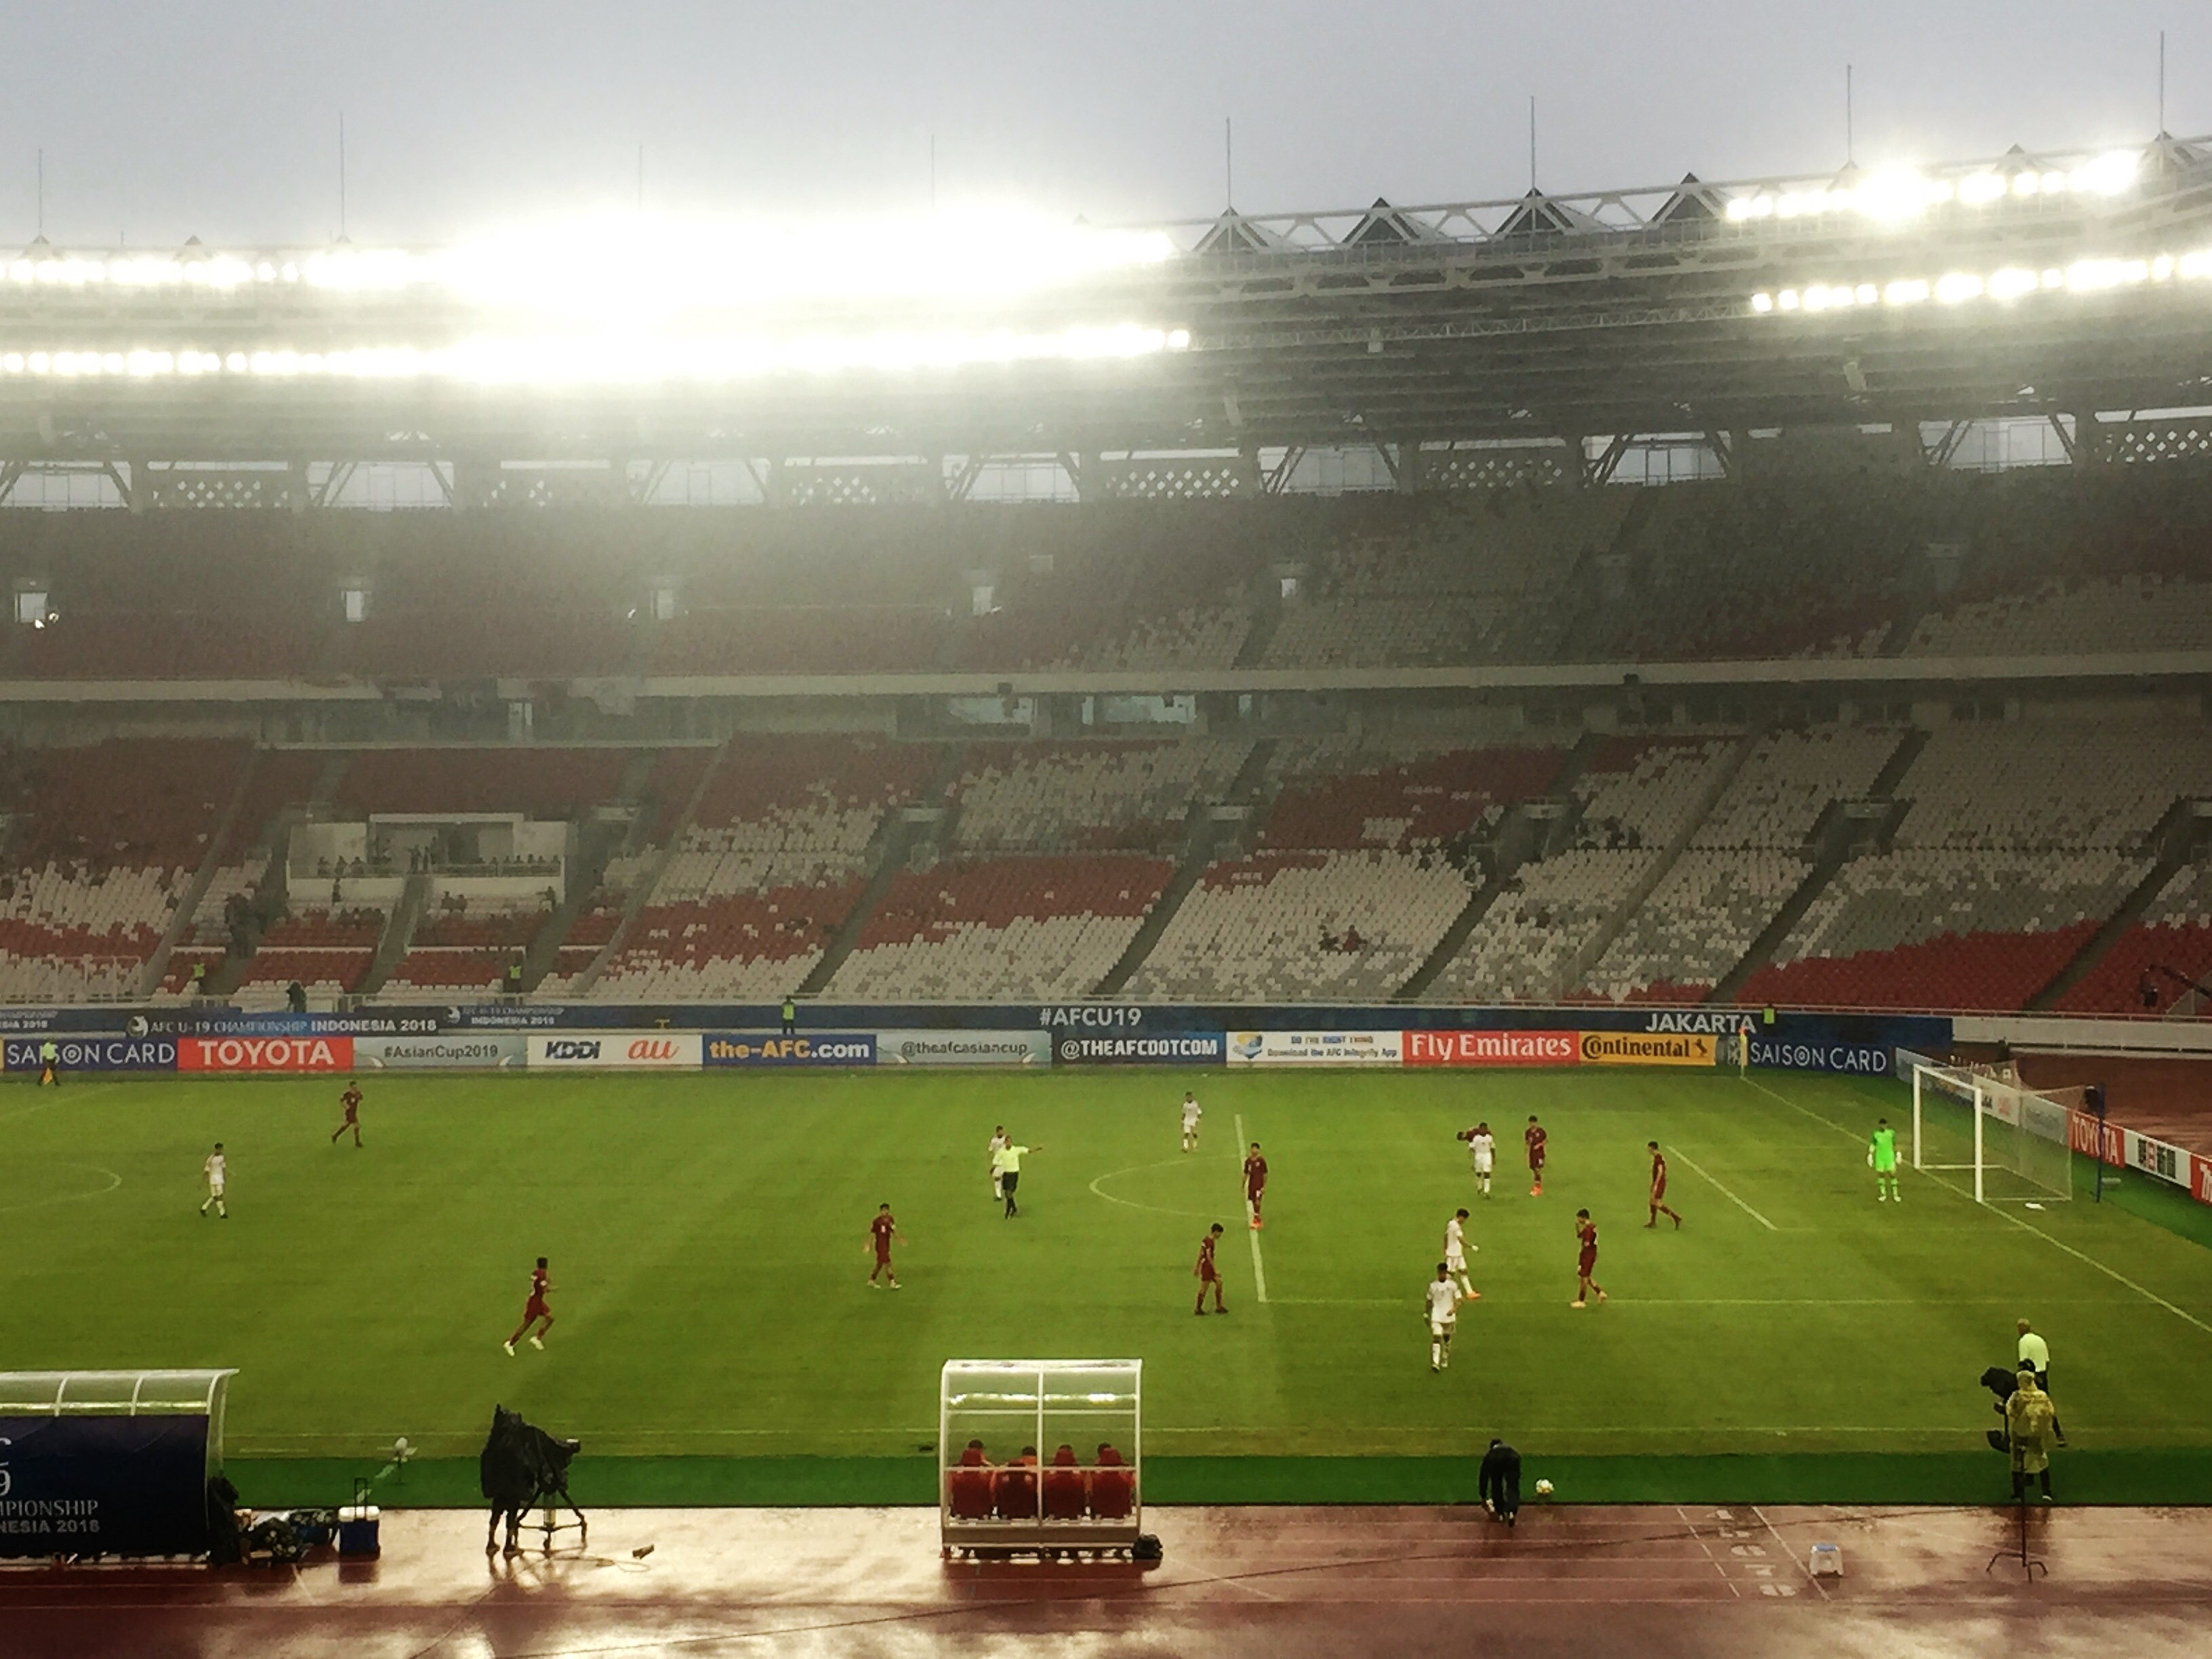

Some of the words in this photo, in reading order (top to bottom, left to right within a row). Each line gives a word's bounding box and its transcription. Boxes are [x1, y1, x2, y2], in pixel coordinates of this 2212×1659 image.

[150, 1021, 173, 1033] AFC
[311, 1020, 396, 1031] INDONESIA
[401, 1019, 437, 1031] 2018
[1039, 1007, 1141, 1026] #AFCU19
[1645, 1012, 1757, 1033] JAKARTA
[106, 1042, 176, 1065] CARD
[197, 1040, 335, 1066] TOYOTA
[384, 1044, 499, 1060] #AsianCup2019
[545, 1040, 601, 1059] KDDI
[628, 1039, 680, 1059] au
[709, 1040, 869, 1059] the-AFC.com
[901, 1041, 1029, 1057] @theafcasiancup
[1061, 1039, 1218, 1060] @THEAFCDOTCOM
[1411, 1033, 1454, 1061] Fly
[1458, 1033, 1572, 1058] Emirates
[1582, 1035, 1690, 1060] Continental
[1750, 1041, 1825, 1067] SAISON
[1829, 1047, 1887, 1073] CARD
[0, 1499, 99, 1517] PIONSHIP
[56, 1519, 101, 1533] 2018
